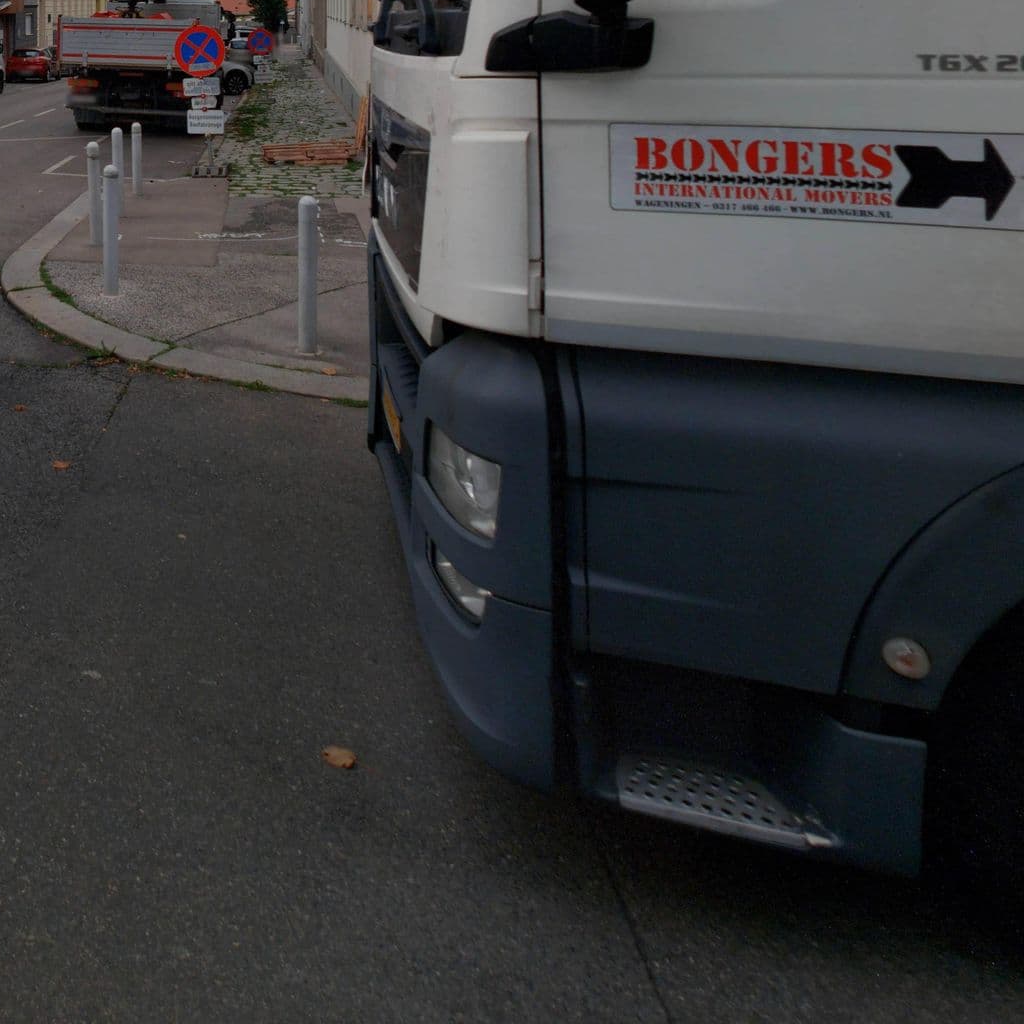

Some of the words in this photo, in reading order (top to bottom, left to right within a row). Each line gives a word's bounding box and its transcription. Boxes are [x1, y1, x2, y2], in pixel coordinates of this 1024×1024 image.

[915, 53, 988, 72] TGX
[633, 136, 894, 179] BONGERS
[633, 182, 798, 201] INTERNATIONAL
[804, 188, 894, 207] MOVERS
[634, 199, 701, 209] WAGENINGEN
[789, 205, 894, 219] WWW.BONGERS.NL
